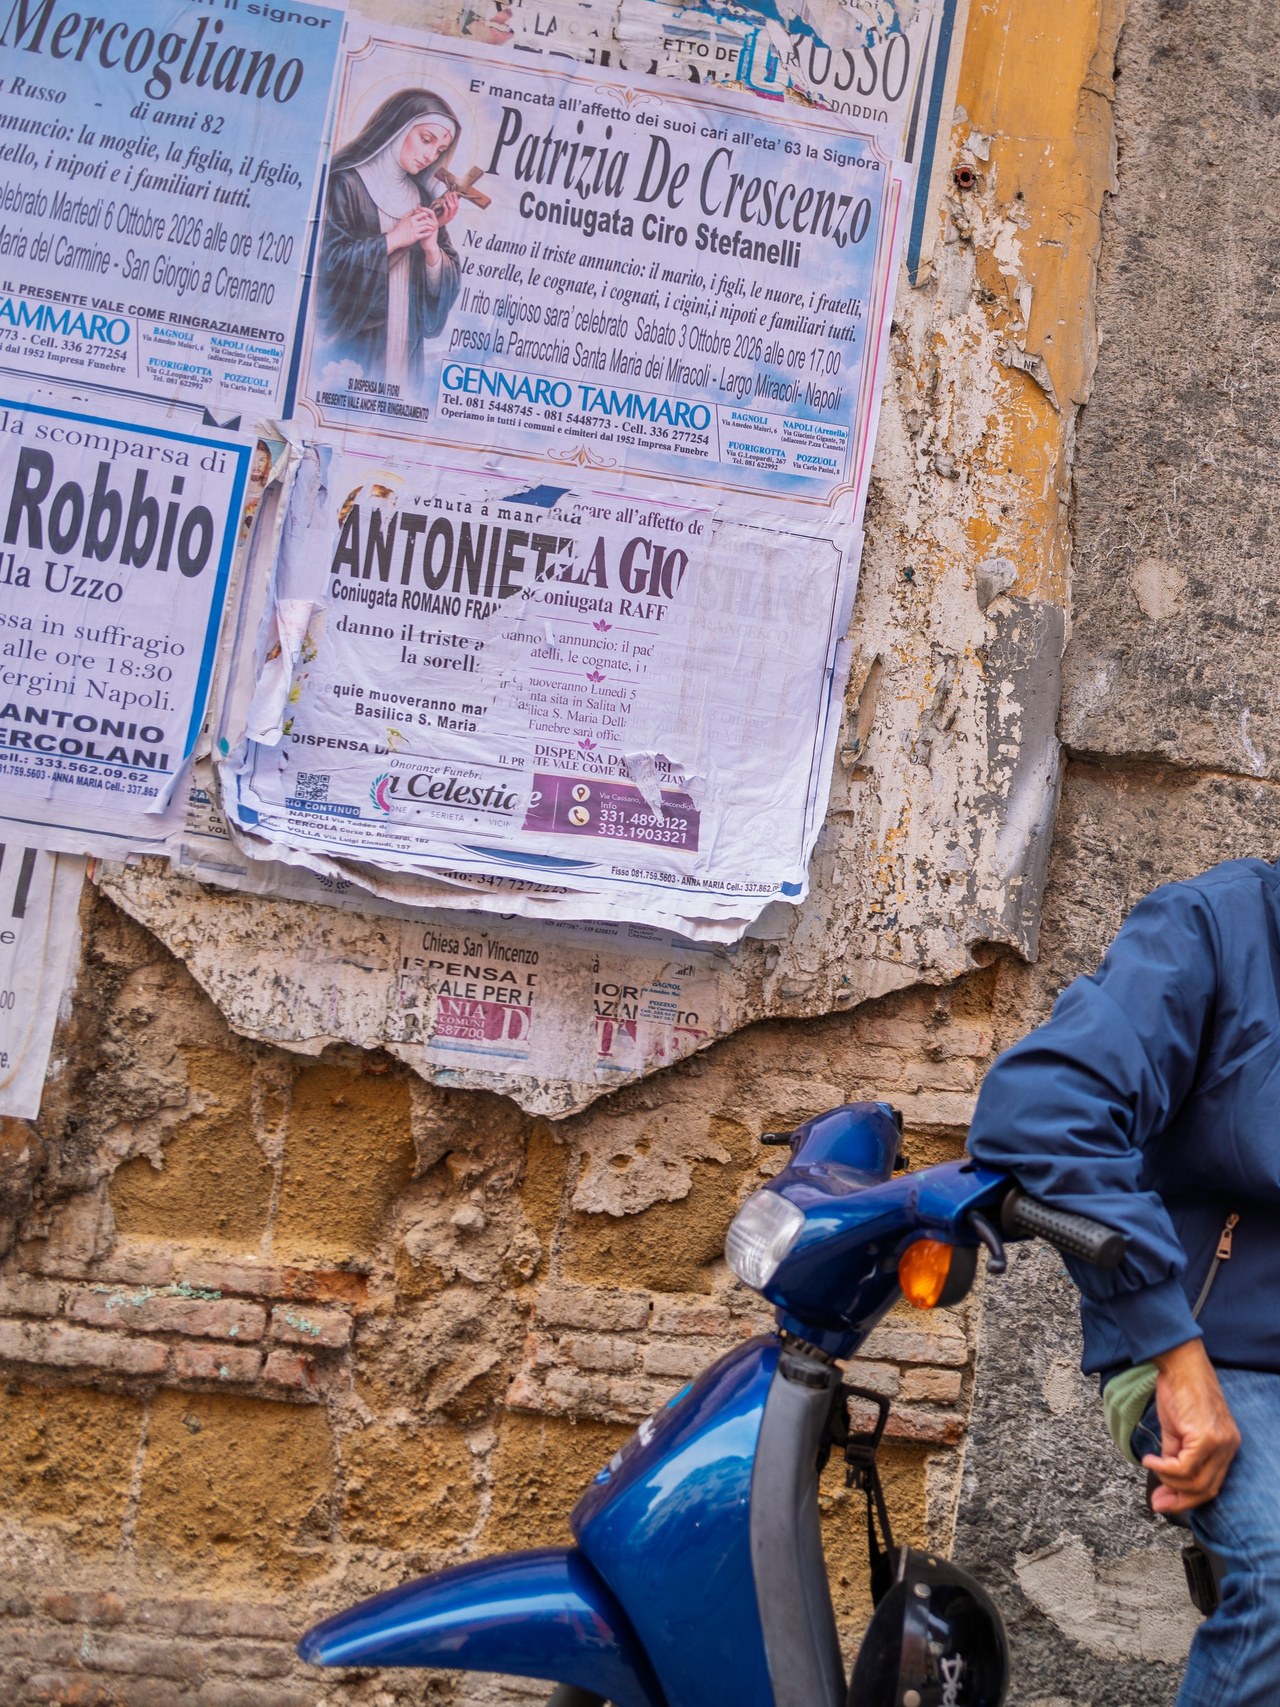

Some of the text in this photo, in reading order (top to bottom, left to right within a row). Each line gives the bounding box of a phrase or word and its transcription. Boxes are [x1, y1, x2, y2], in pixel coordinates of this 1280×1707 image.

[247, 3, 332, 28] signor
[0, 0, 303, 103] Mercogliano
[9, 76, 225, 135] Russo di anni 82
[489, 85, 880, 172] mancata dei suoi cari 63 Signora
[99, 132, 302, 189] moglie, la figlia, figlio,
[485, 105, 872, 249] Patrizia De Crescenzo
[55, 154, 251, 209] nipoti familiari tutti.
[117, 203, 294, 265] Ottobre 2026 alle ore 12:00
[518, 191, 802, 269] Coniugata Ciro Stefanelli
[30, 232, 276, 306] del Carmine San Giorgio Cremano
[462, 228, 862, 320] Ne danno triste annuncio: marito, figli, nuore, fratelli,
[19, 284, 286, 343] PRESENTE VALE COME RINGRAZIAMENTO
[477, 261, 856, 342] sorelle, cognate, nipoti familiari tutti.
[30, 334, 128, 361] Cell. 336 277254
[470, 289, 841, 377] rito religioso celebrato Sabato Ottobre 2026 alle ore 17,00
[6, 344, 126, 373] dal 1952 Impresa Funebre
[449, 327, 843, 414] presso Parrocchia Santa Maria dei Miracoli Largo Napoli
[442, 363, 711, 430] GENNARO TAMMARO
[441, 407, 709, 457] Operiamo comuni cimiteri dal 1952 Impresa Funebre
[442, 393, 710, 445] Tel. 081 5448745 5448773 Cell. 336 277254
[731, 412, 768, 425] BAGNOLI
[35, 424, 228, 474] scomparsa di
[728, 441, 786, 458] FUORIGROTTA
[757, 462, 778, 471] 622992
[3, 445, 215, 579] Robbio
[44, 560, 124, 602] Uzzo
[332, 578, 461, 616] Coniugata ROMANO
[41, 614, 186, 659] in suffragio
[336, 615, 469, 650] danno triste
[559, 636, 618, 652] annuncio:
[3, 639, 173, 682] alle ore 18:30
[582, 655, 632, 674] cognate,
[86, 678, 176, 712] Napoli.
[369, 690, 457, 712] muoveranno
[586, 699, 616, 713] Salita
[0, 703, 165, 744] ANTONIO
[354, 702, 477, 732] Basilica Maria
[528, 719, 571, 736] Funebre
[566, 711, 599, 724] Maria
[34, 757, 149, 783] 333.562.09.62
[390, 759, 441, 774] Onoranze
[535, 744, 604, 765] DISPENSA
[51, 772, 103, 789] ANNA MARIA
[304, 802, 361, 816] CONTINUO
[430, 810, 465, 822] SERIETÀ
[600, 800, 618, 811] Info
[287, 818, 338, 832] CERCOLA
[287, 826, 321, 838] VOLLA
[598, 823, 687, 843] 333.1903321
[611, 866, 701, 888] Fisso 081.759.5603 ANNA
[422, 931, 539, 965] Chiesa San Vincenzo
[440, 1016, 485, 1028] COMUNI
